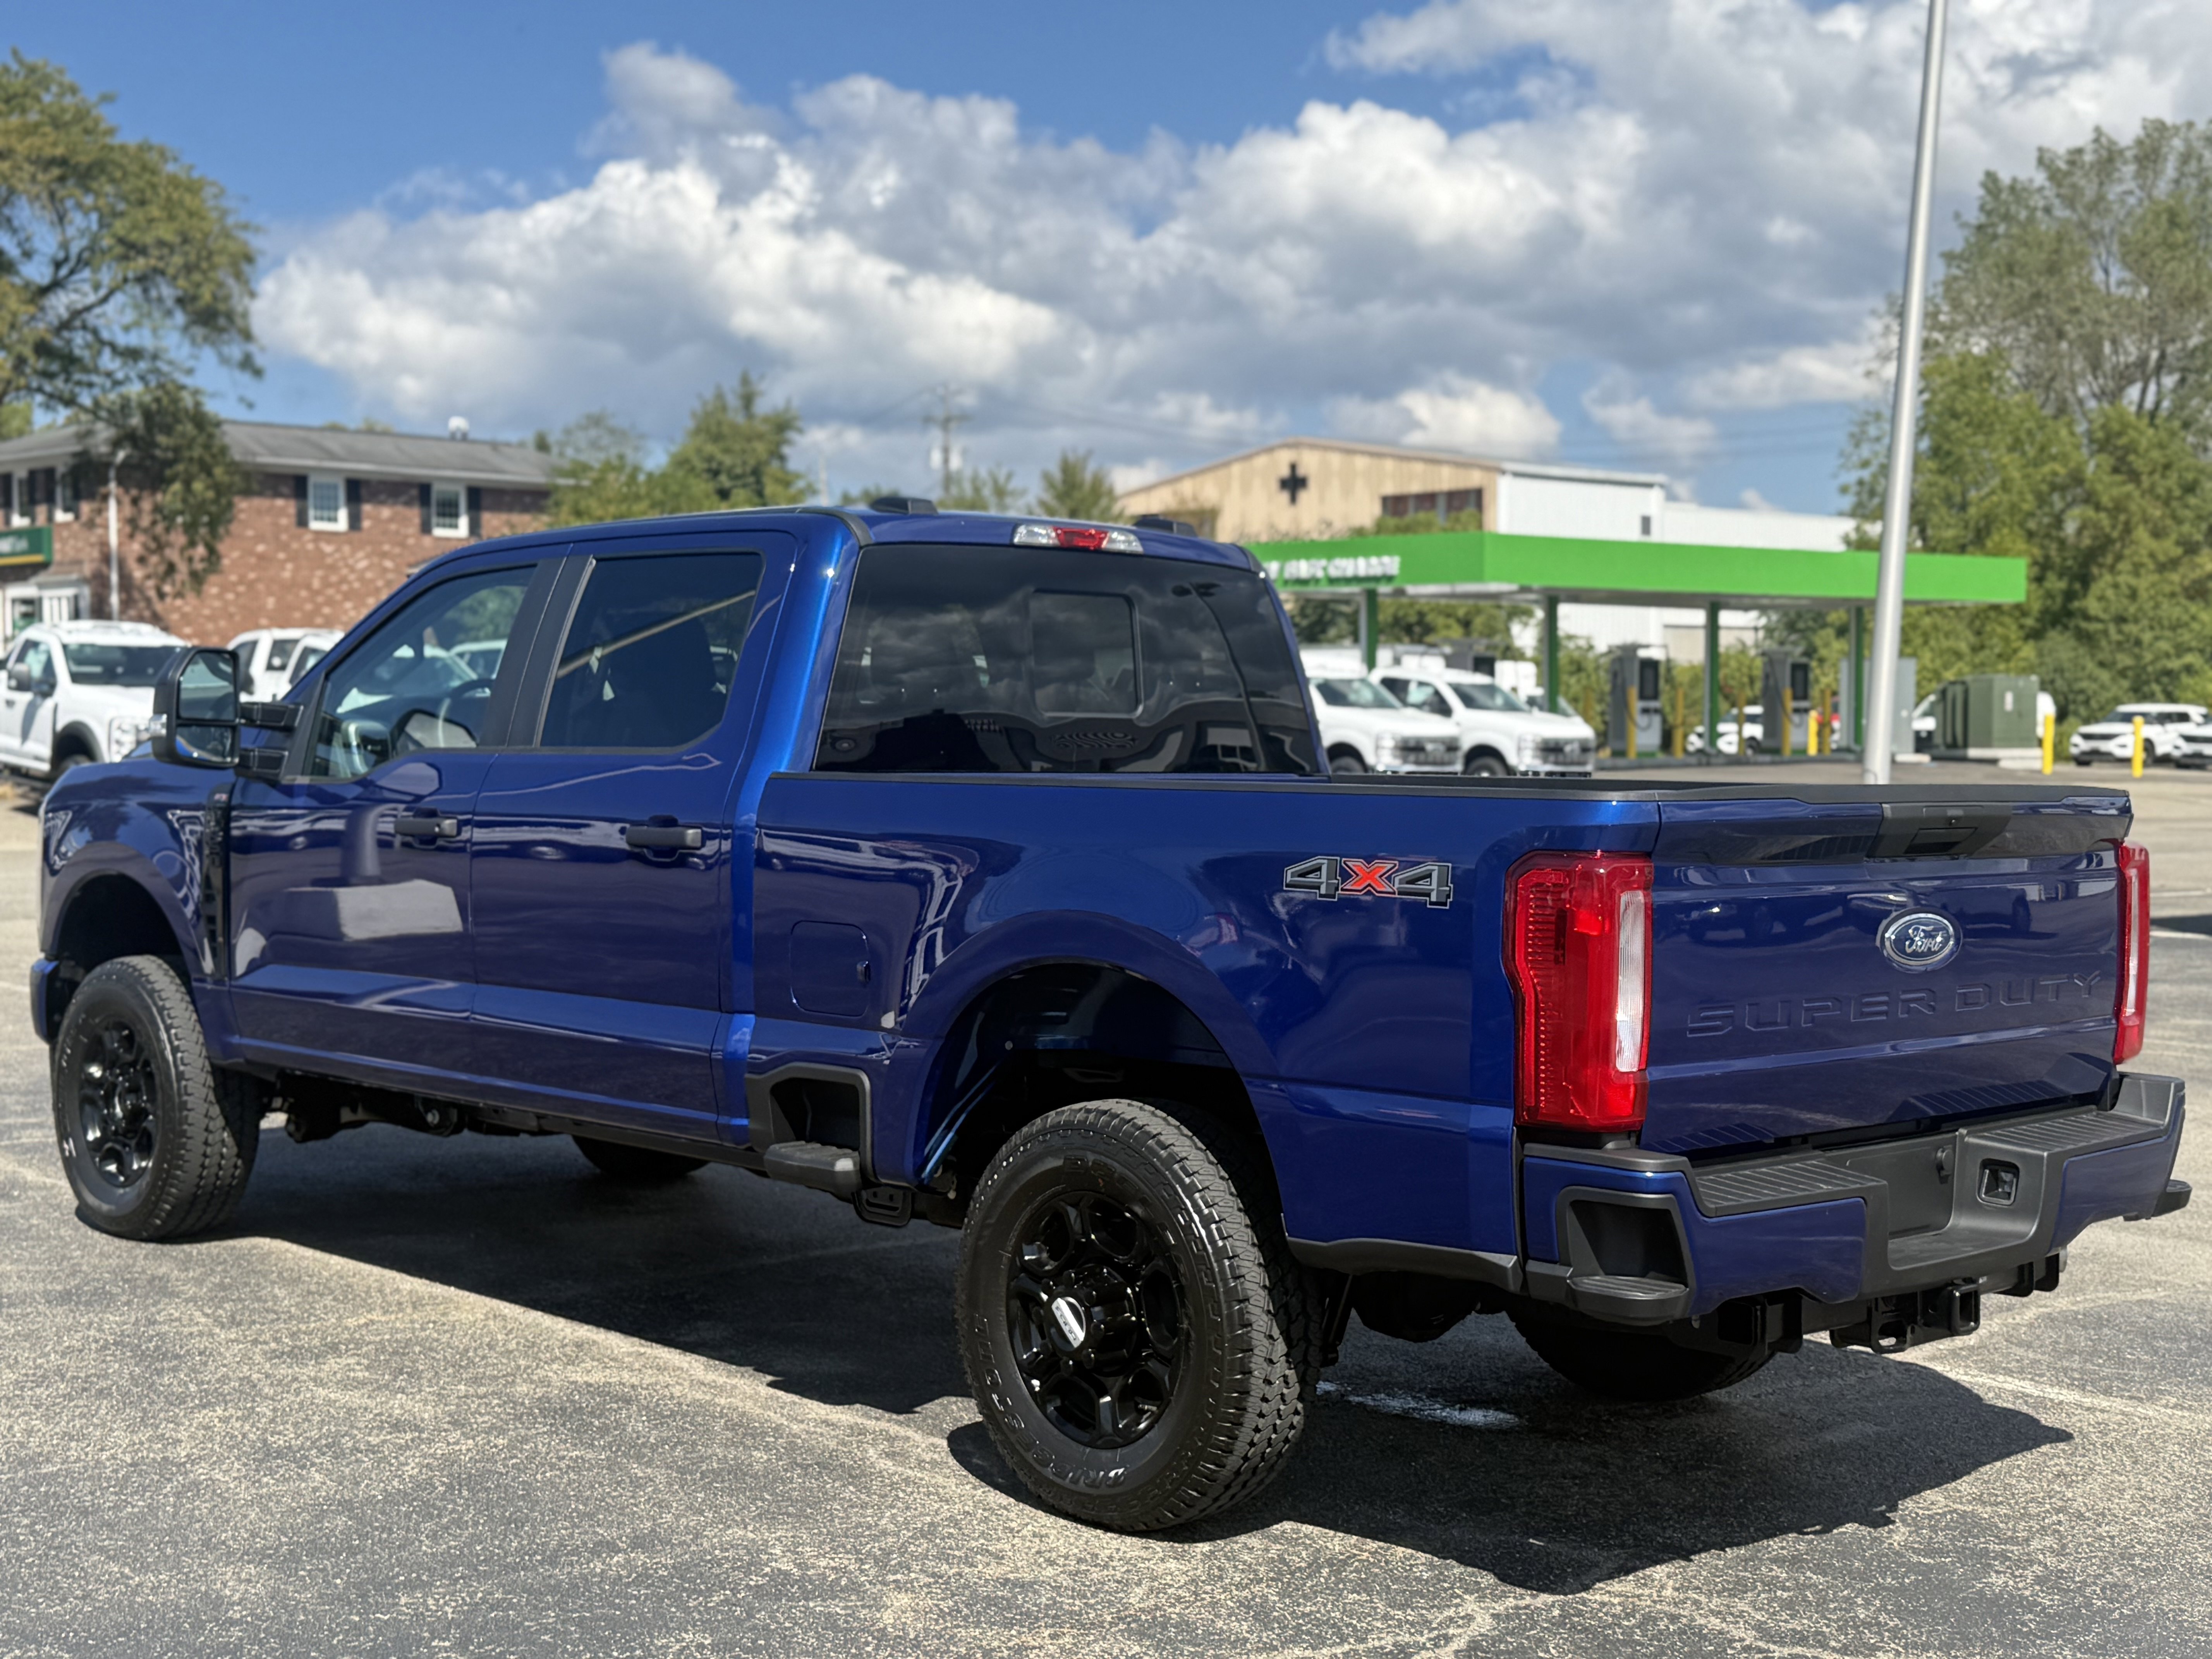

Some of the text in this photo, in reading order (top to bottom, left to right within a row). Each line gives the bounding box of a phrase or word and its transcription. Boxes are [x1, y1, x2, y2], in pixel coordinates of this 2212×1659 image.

[1906, 925, 1944, 953] Ford
[1687, 970, 2101, 1037] SUPER DUTY
[975, 1314, 1127, 1488] BRIDGESTONE
